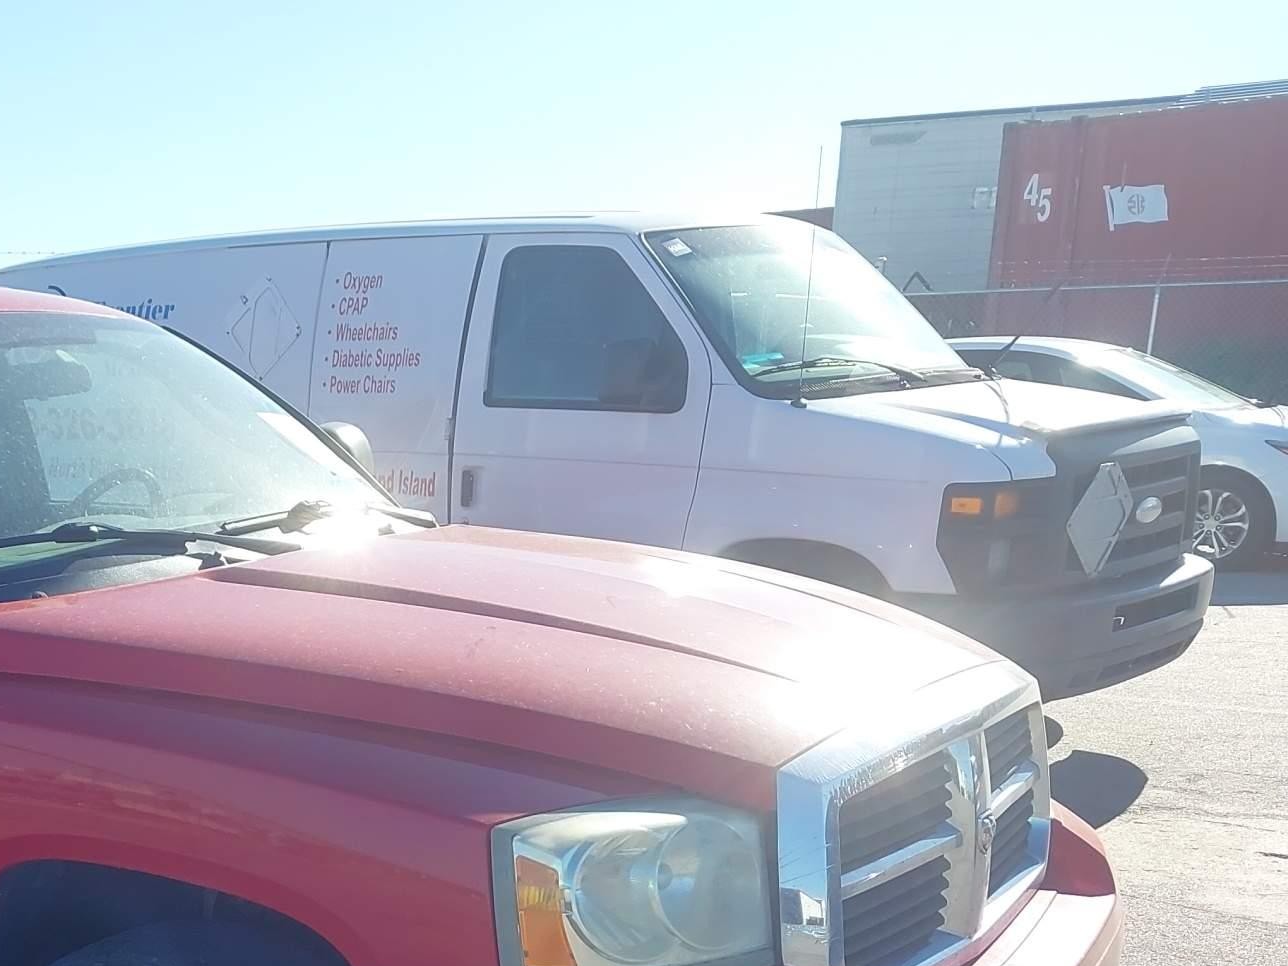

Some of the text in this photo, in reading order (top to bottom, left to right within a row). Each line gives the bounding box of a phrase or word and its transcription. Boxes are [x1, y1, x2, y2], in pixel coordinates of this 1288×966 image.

[1024, 173, 1052, 222] 45
[343, 271, 383, 294] Oxygen
[338, 297, 369, 315] CPAP
[336, 322, 399, 342] Wheelchairs
[331, 347, 421, 371] Diabetic Supplies
[329, 375, 397, 394] Power Chairs
[398, 469, 436, 497] Island
